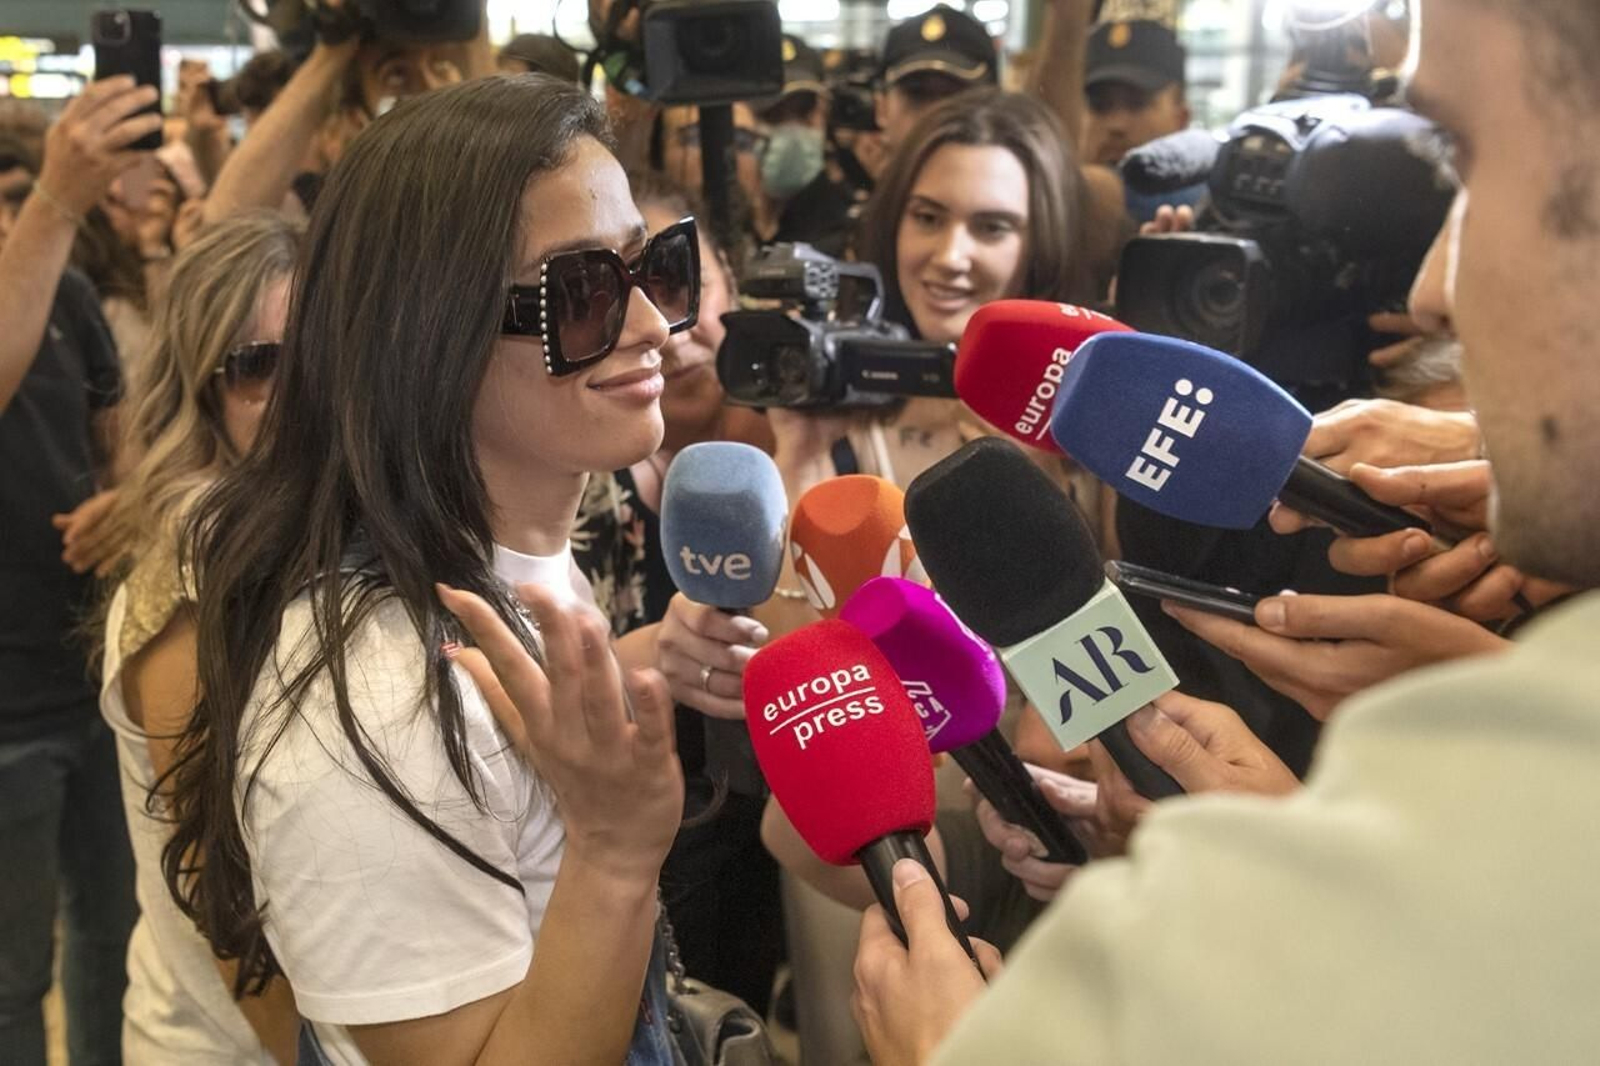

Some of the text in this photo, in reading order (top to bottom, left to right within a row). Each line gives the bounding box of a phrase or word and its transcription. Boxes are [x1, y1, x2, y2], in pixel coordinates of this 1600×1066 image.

[1014, 347, 1073, 435] europa
[680, 546, 751, 580] tve
[763, 664, 872, 722] europa
[1052, 626, 1156, 726] AR
[793, 695, 884, 750] press
